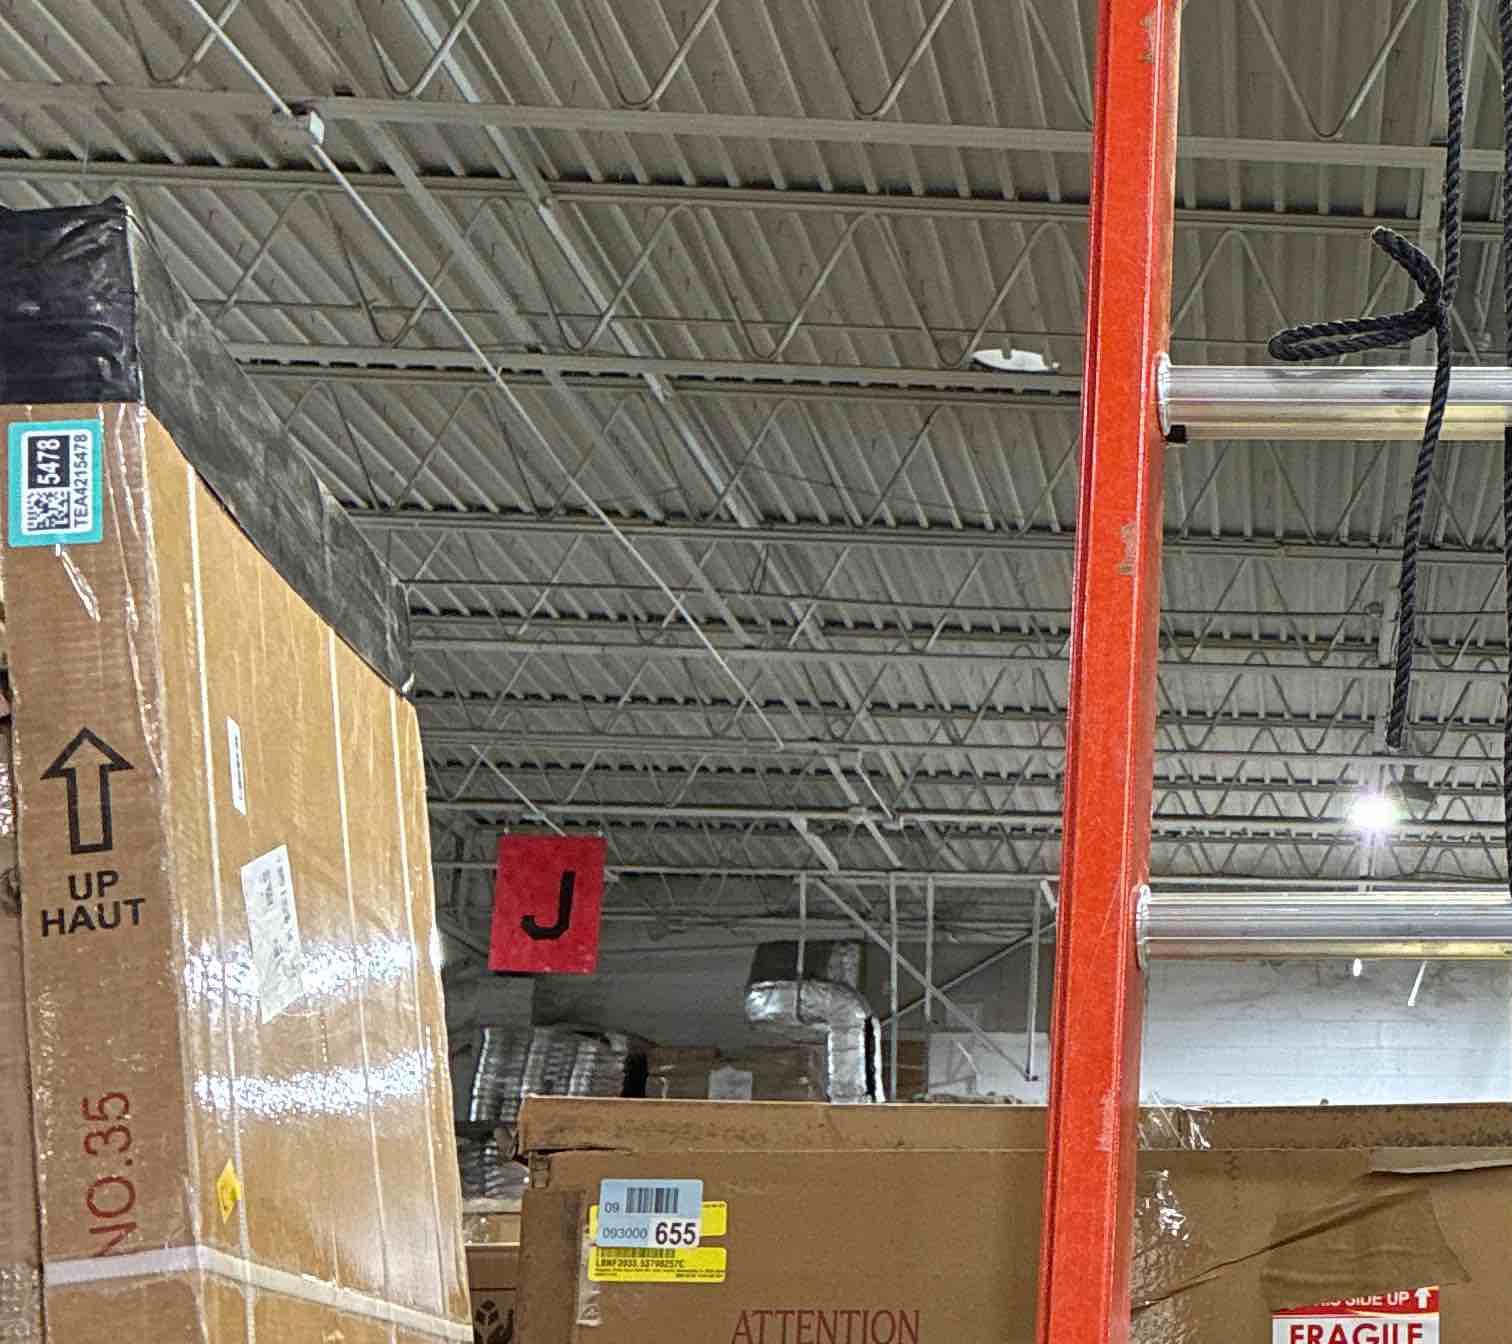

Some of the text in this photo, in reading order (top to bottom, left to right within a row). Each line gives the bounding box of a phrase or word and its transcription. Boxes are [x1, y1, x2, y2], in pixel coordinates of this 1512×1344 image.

[36, 438, 61, 485] 5478
[73, 433, 89, 528] TEA4215478
[67, 869, 119, 901] UP
[520, 869, 576, 941] J
[41, 897, 146, 937] HAUT
[80, 1091, 137, 1256] NO.35
[604, 1201, 620, 1214] 09
[602, 1221, 697, 1246] 093000 655
[1387, 1291, 1410, 1306] UP
